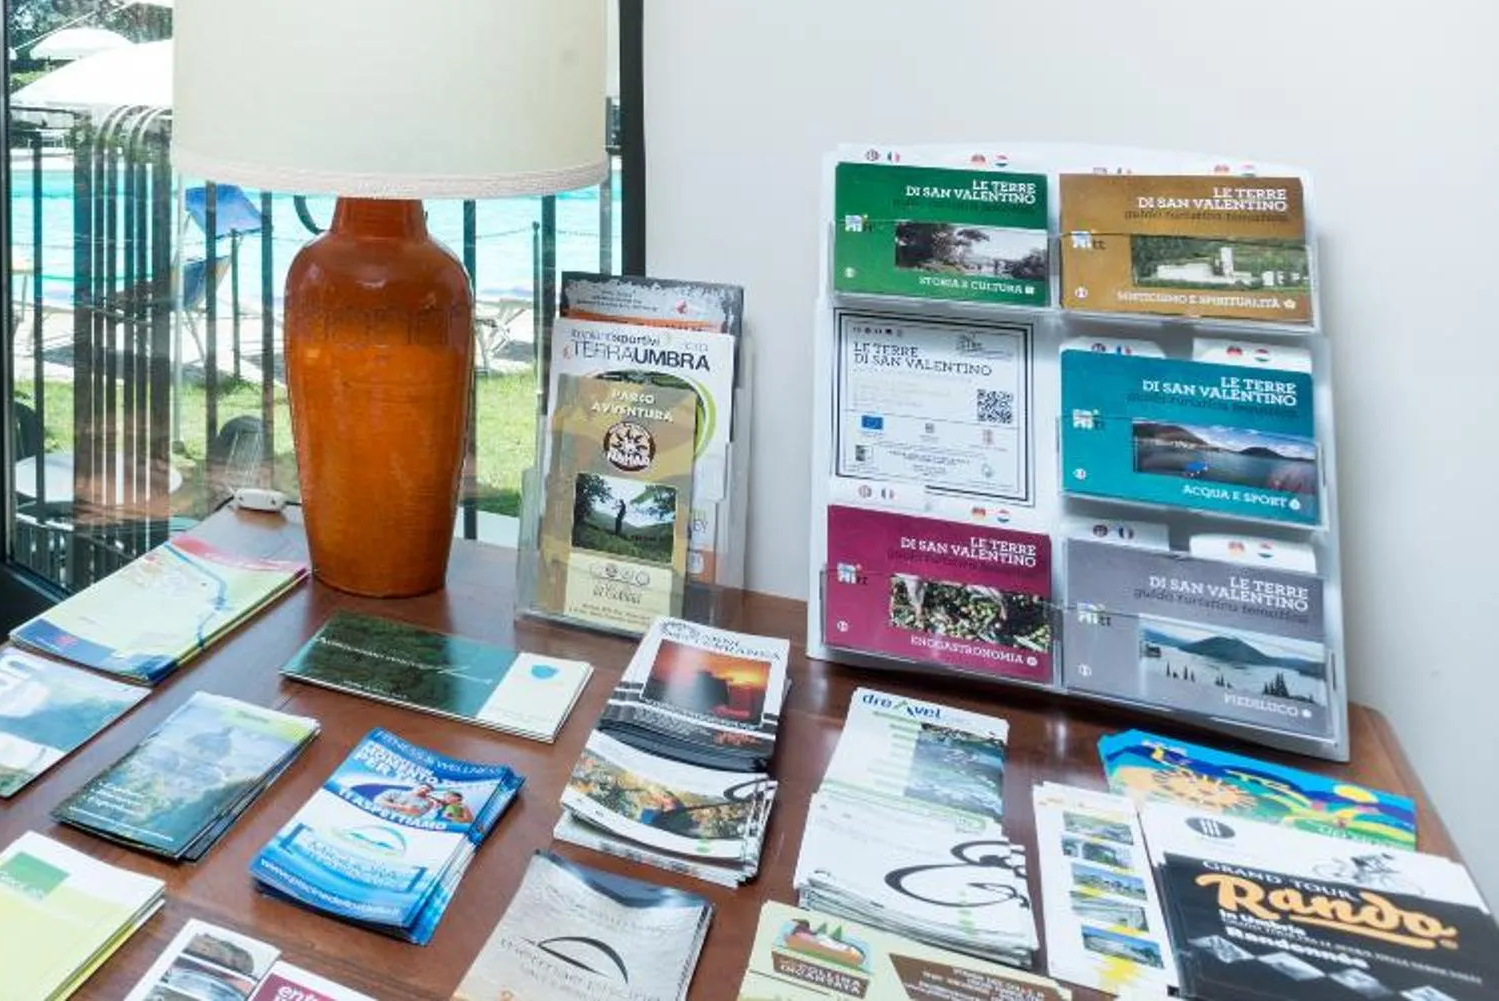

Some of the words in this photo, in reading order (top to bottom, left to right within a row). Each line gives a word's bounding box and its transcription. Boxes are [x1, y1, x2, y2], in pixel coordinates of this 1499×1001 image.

[906, 186, 919, 197] DI
[923, 187, 950, 199] SAN
[954, 189, 1036, 204] VALENTINO
[973, 180, 988, 191] LE
[994, 181, 1036, 194] TERRE
[1213, 187, 1233, 198] LE
[1235, 188, 1286, 200] TERRE
[1138, 197, 1154, 208] DI
[1158, 198, 1189, 209] SAN
[1192, 199, 1287, 211] VALENTINO
[971, 280, 1022, 294] CULTURA
[854, 341, 870, 353] LE
[873, 343, 919, 357] TERRE
[854, 353, 869, 364] DI
[872, 355, 900, 366] SAN
[905, 357, 992, 376] VALENTINO
[1142, 380, 1159, 392] DI
[1163, 382, 1195, 395] SAN
[1200, 385, 1296, 406] VALENTINO
[1221, 377, 1239, 389] LE
[1243, 379, 1296, 394] TERRE
[1182, 485, 1229, 500] ACQUA
[1244, 492, 1286, 507] SPORT
[901, 537, 916, 548] DI
[919, 538, 948, 553] SAN
[950, 544, 1036, 567] VALENTINO
[971, 537, 987, 548] LE
[990, 539, 1036, 556] TERRE
[1149, 576, 1167, 588] DI
[1170, 579, 1203, 594] SAN
[1207, 584, 1308, 612] VALENTINO
[1230, 576, 1250, 589] LE
[1253, 580, 1308, 599] TERRE
[1203, 860, 1282, 884] GRAND
[1290, 879, 1362, 902] TOUR
